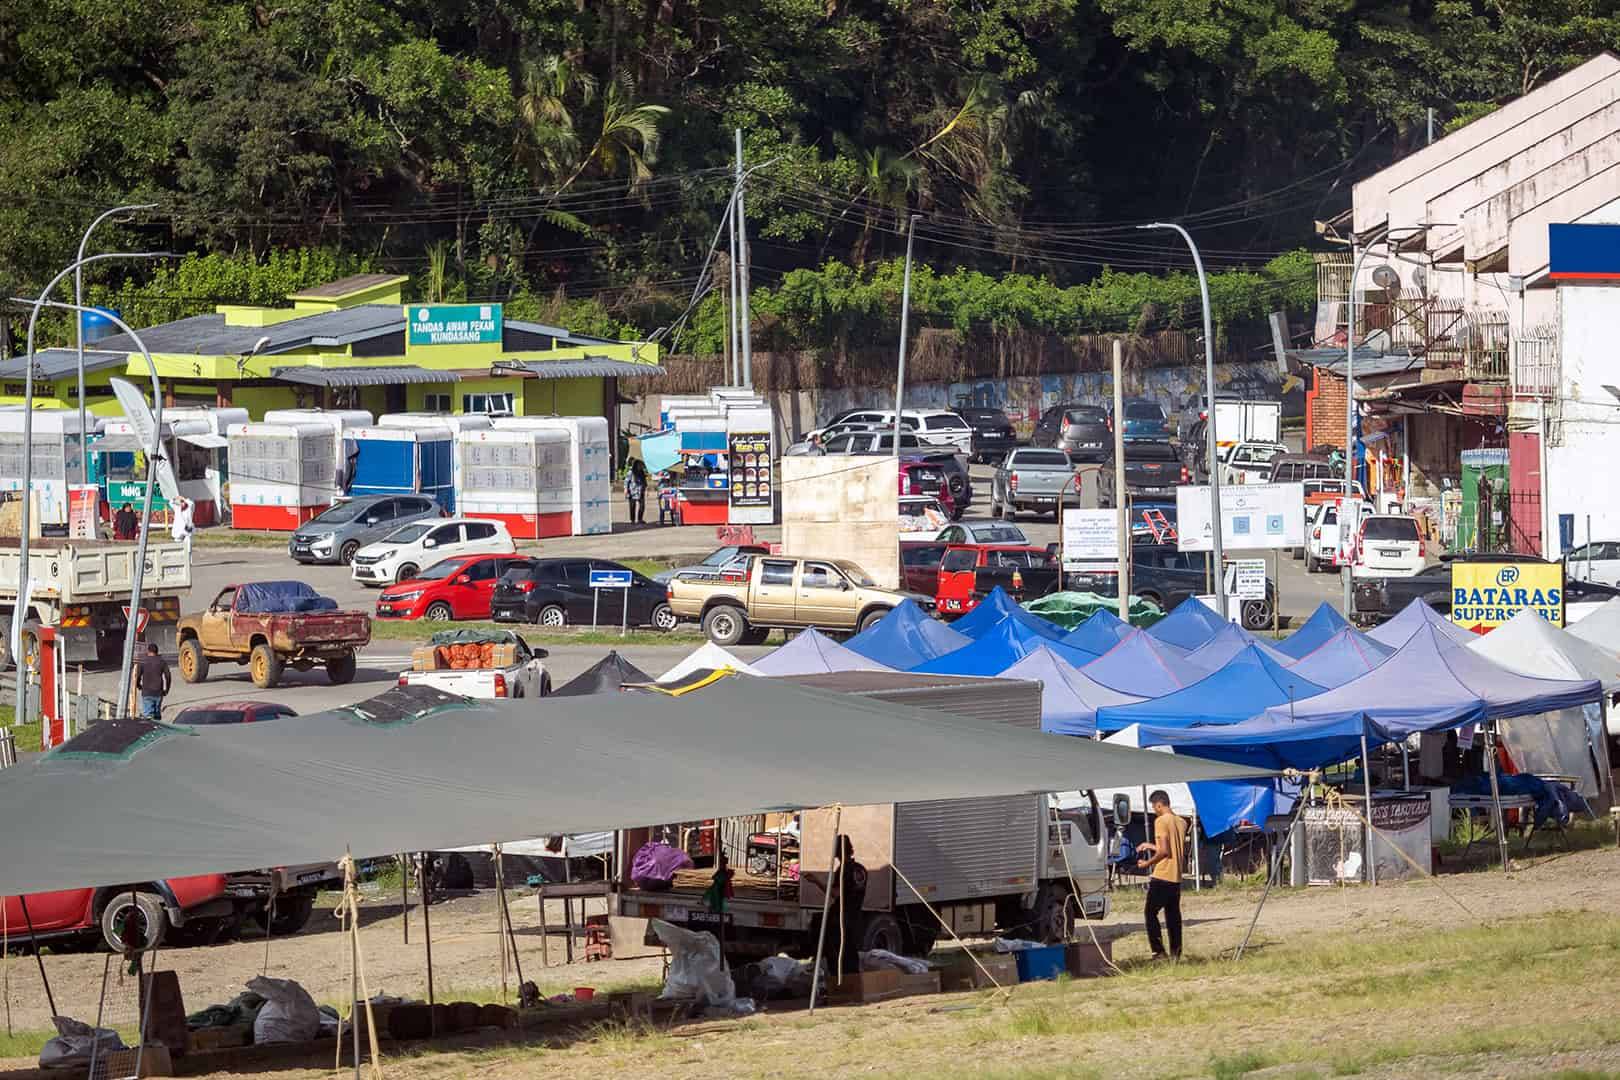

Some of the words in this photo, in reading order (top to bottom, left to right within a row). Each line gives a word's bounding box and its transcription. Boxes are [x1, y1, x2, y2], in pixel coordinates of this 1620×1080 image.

[412, 321, 444, 333] TANDAS
[446, 321, 468, 332] AWAM
[470, 320, 495, 332] PEKAN
[431, 332, 481, 344] KUNDASANG
[1203, 522, 1212, 531] A
[1271, 519, 1280, 529] C
[1454, 588, 1561, 606] BATARAS
[1454, 608, 1561, 622] SUPERSRE
